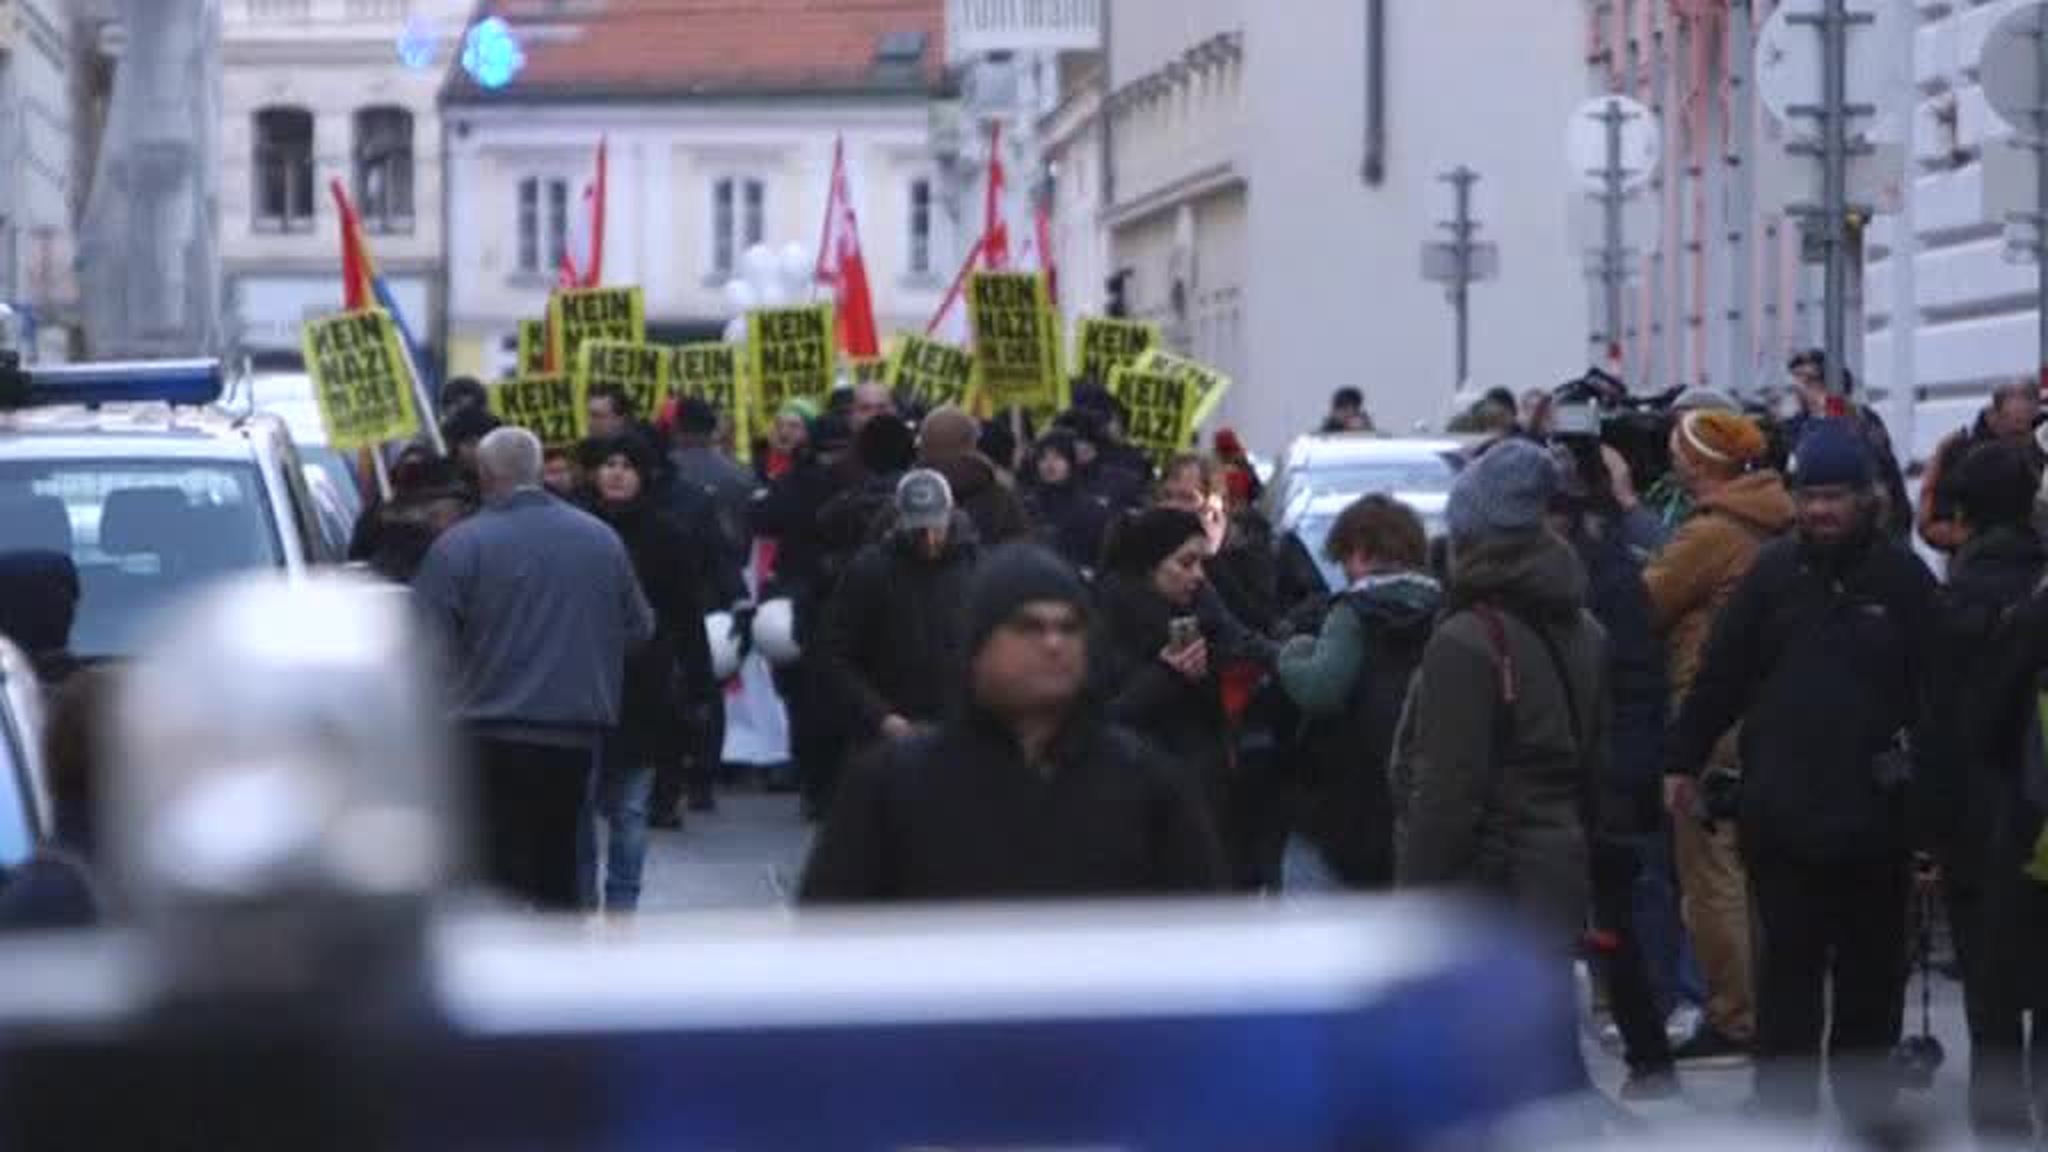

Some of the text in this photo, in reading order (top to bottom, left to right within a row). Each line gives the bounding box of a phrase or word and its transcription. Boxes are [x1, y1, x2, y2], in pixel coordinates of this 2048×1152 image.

[562, 291, 631, 321] KEIN
[976, 275, 1037, 306] KEIN
[308, 312, 384, 355] KEIN
[761, 309, 824, 341] KEIN
[978, 308, 1039, 338] NAZI
[1087, 322, 1150, 354] KEIN
[319, 348, 394, 385] NAZI
[590, 347, 658, 383] KEIN
[669, 348, 733, 380] KEIN
[762, 342, 826, 371] NAZI
[902, 334, 974, 379] KEIN
[501, 382, 573, 414] KEIN
[1117, 373, 1185, 410] KEIN
